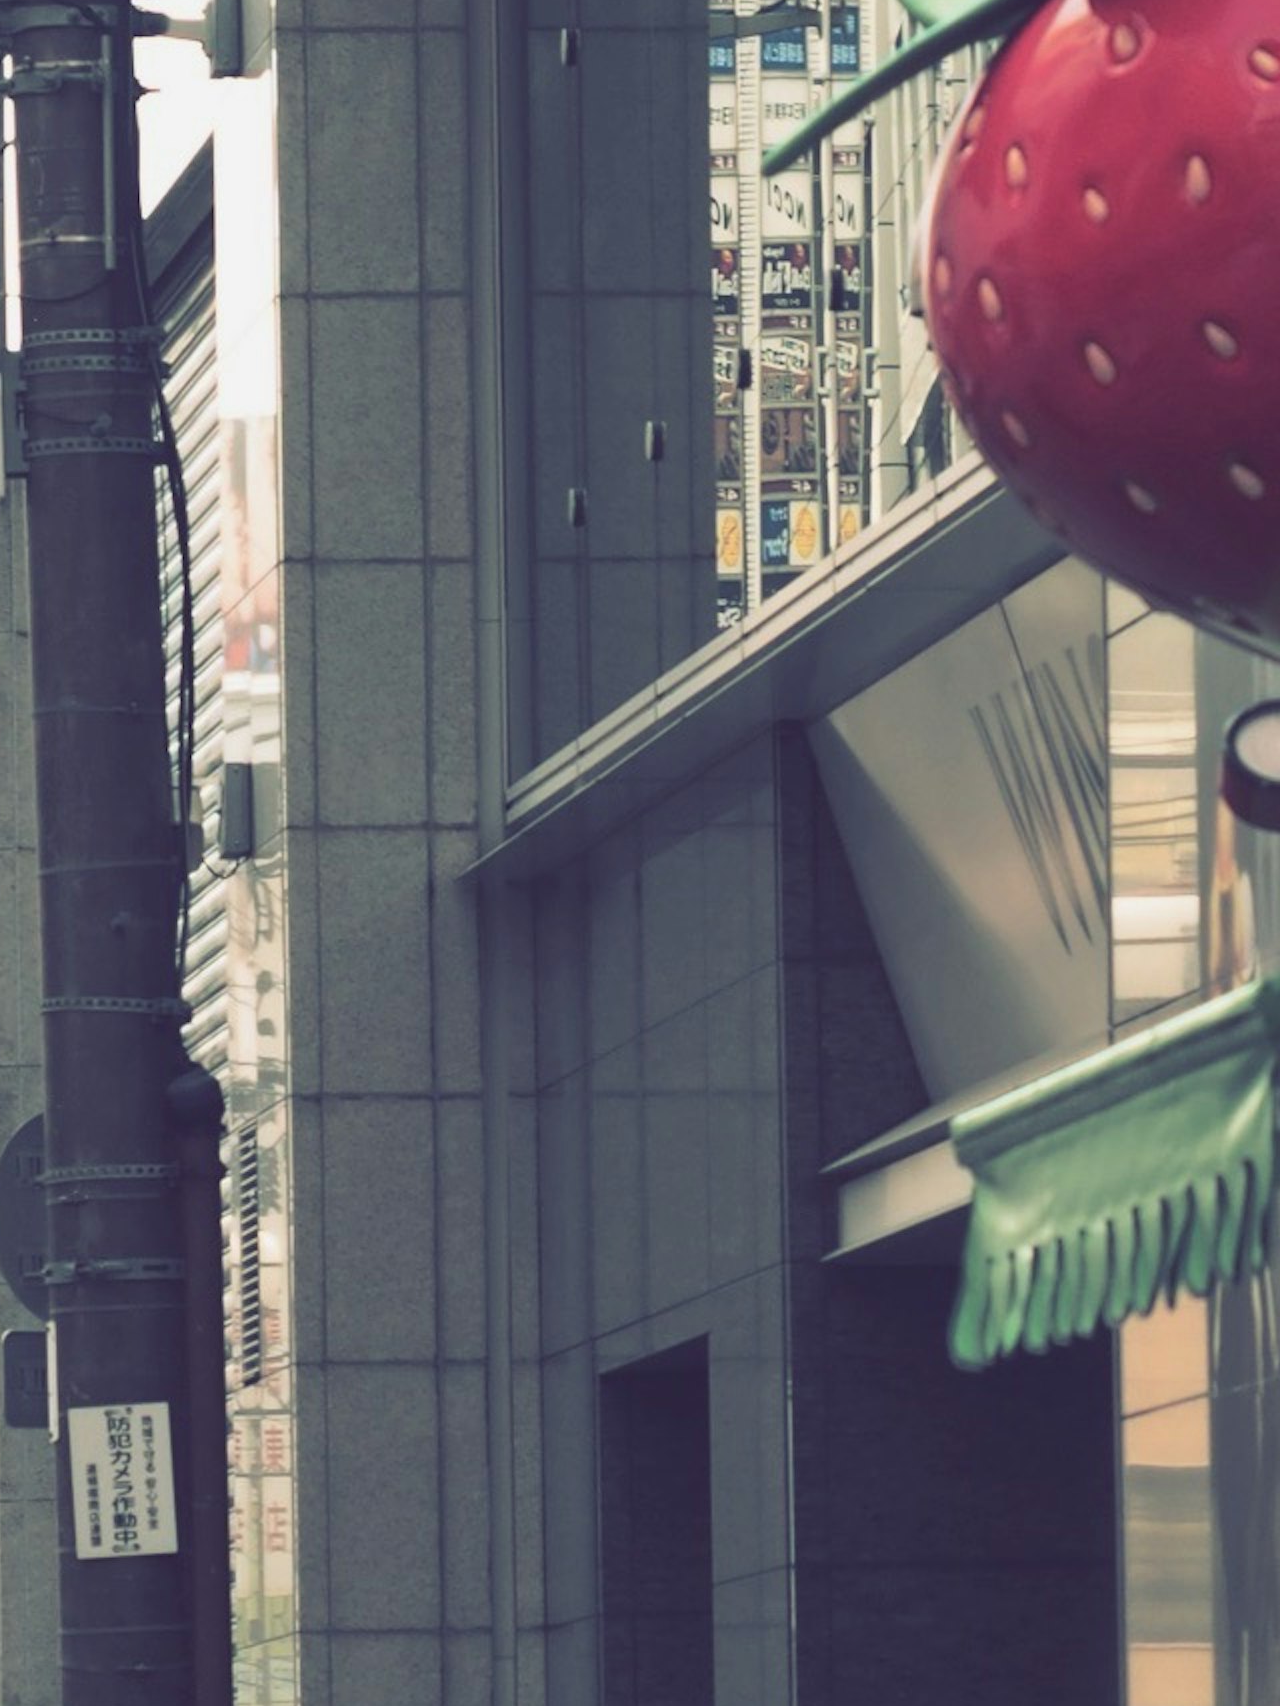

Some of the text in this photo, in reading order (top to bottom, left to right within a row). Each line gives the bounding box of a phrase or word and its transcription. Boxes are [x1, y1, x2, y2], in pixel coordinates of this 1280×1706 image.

[108, 1417, 138, 1543] 防犯カメラ作動中
